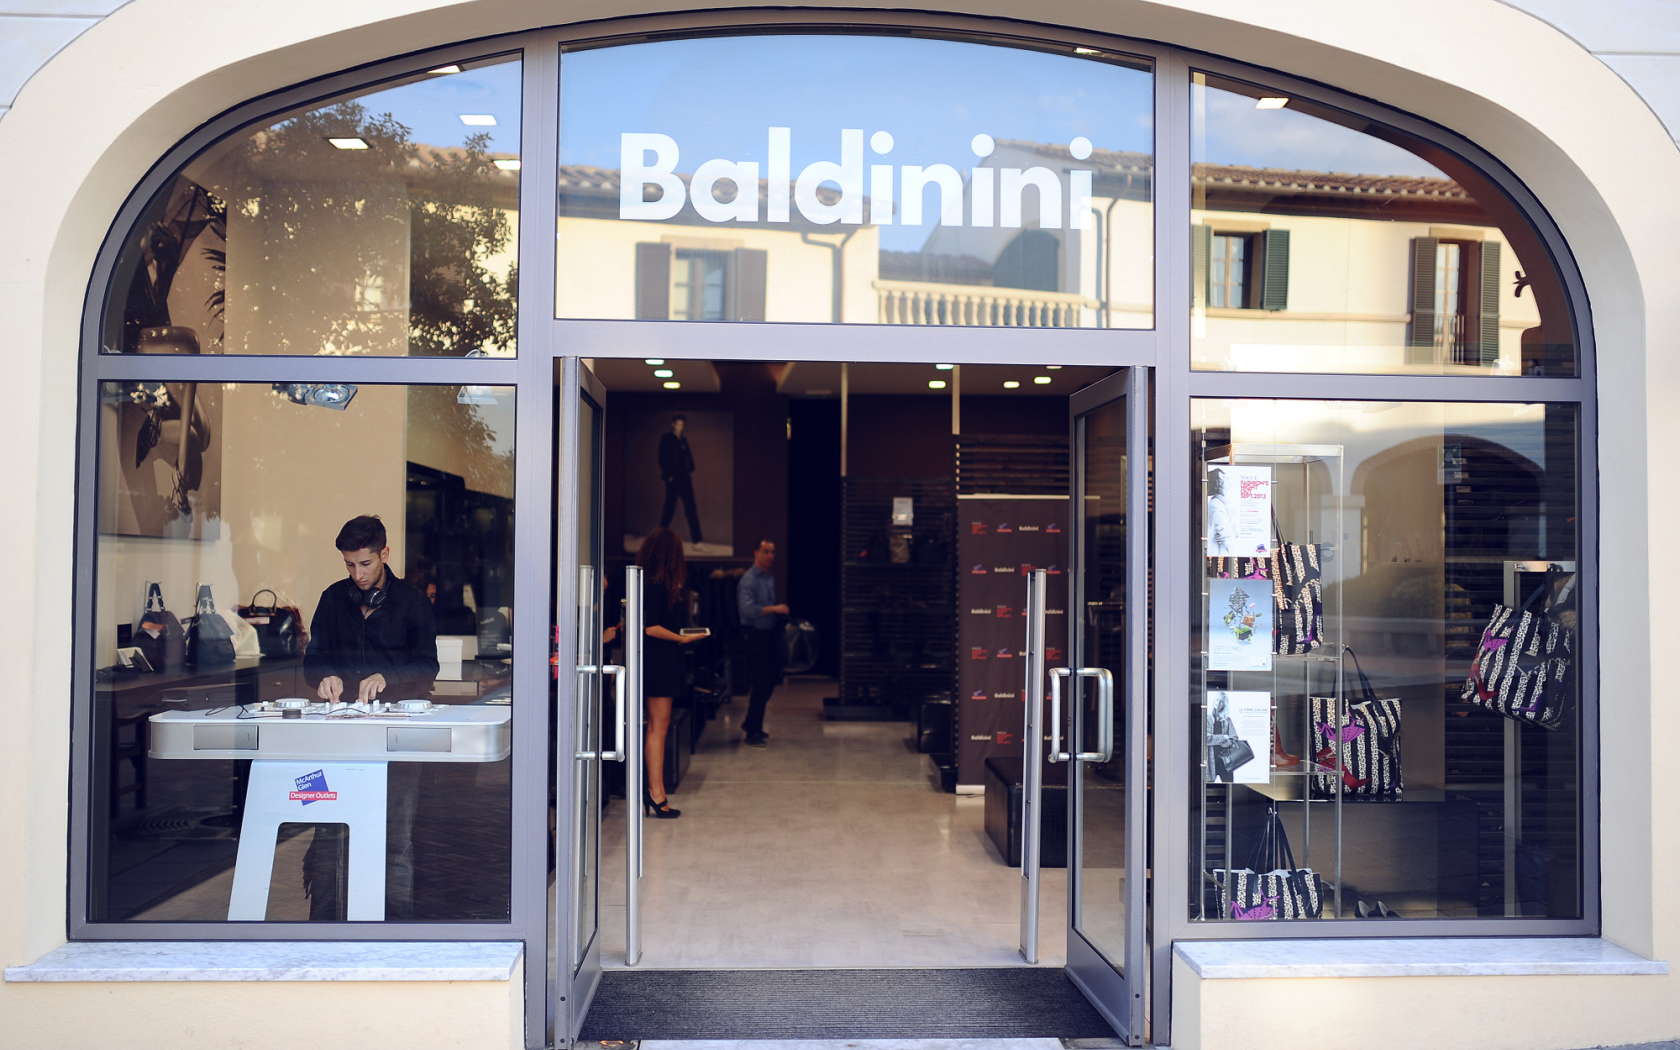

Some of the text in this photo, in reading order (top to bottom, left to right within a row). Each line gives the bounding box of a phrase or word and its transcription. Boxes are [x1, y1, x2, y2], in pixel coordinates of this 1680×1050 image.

[619, 126, 1094, 230] Baldinini
[296, 771, 322, 785] McArthur
[297, 782, 312, 791] Glen
[290, 792, 315, 800] Designer
